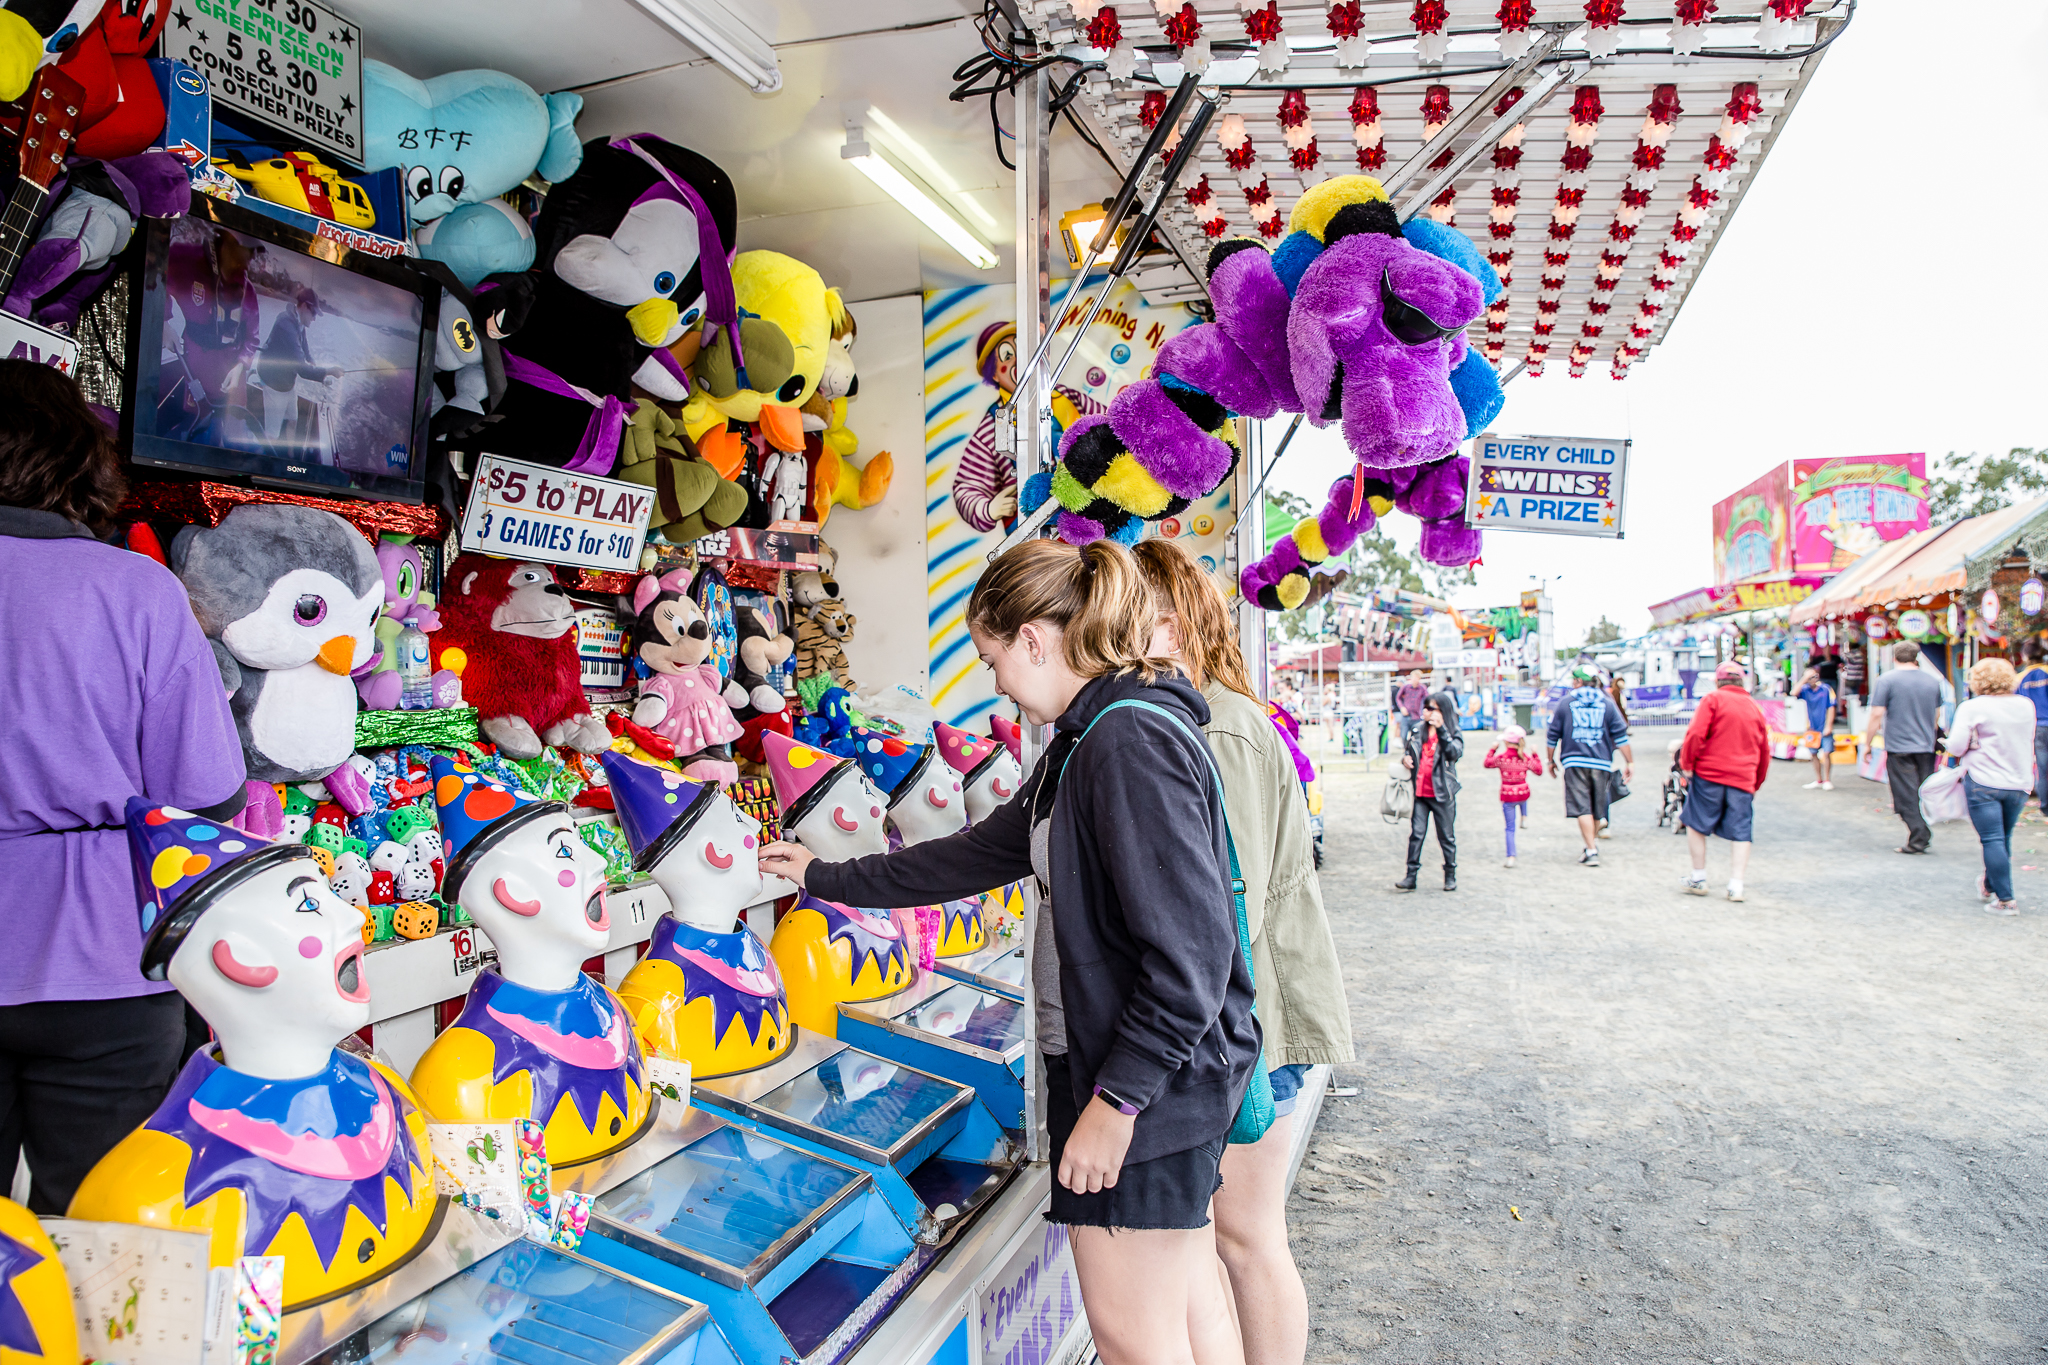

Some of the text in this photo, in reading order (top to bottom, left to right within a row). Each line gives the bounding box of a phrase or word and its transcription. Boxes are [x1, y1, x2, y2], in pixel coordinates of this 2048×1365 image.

[285, 0, 316, 33] 30
[195, 0, 343, 79] GREEN SHELF
[248, 5, 344, 67] PRIZE ON
[226, 31, 317, 96] 5 & 30
[189, 45, 345, 128] CONSECUTIVELY
[222, 78, 355, 149] OTHER PRIZES
[1115, 349, 1124, 358] 30
[1090, 372, 1099, 380] 29
[390, 450, 408, 463] WIN
[1484, 443, 1615, 465] EVERY CHILD
[286, 465, 307, 474] SONY
[1499, 469, 1597, 496] WINS
[489, 465, 645, 524] $5 to PLAY
[1490, 497, 1600, 523] A PRIZE
[477, 512, 634, 559] 3 GAMES for $10
[1166, 524, 1173, 532] 11
[1199, 520, 1207, 528] 12
[1735, 580, 1814, 607] Waffles
[1571, 706, 1606, 728] NSW
[630, 899, 646, 924] 11
[449, 930, 472, 958] 16
[994, 1254, 1039, 1343] Every
[1059, 1269, 1074, 1339] A
